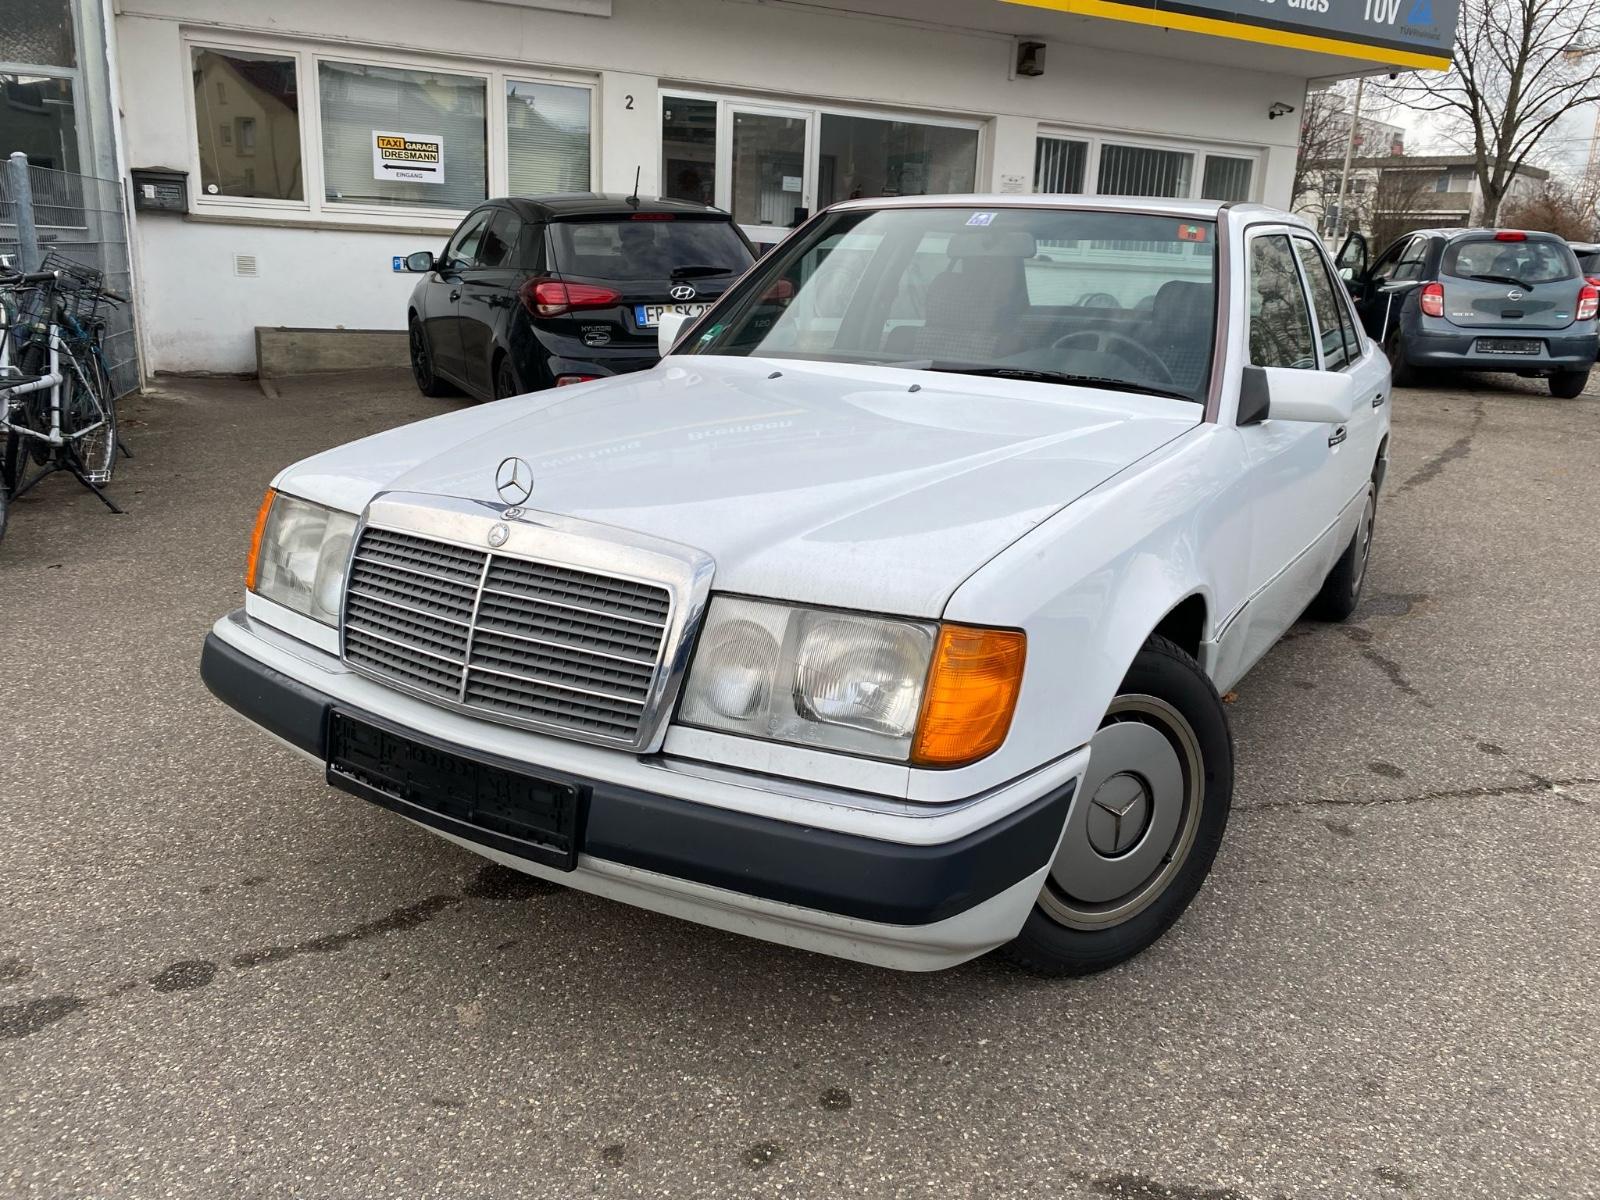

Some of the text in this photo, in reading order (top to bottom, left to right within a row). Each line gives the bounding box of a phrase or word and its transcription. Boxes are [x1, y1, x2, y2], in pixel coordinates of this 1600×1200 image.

[624, 94, 634, 110] 2
[379, 138, 438, 152] TAXI GARAGE
[384, 150, 437, 161] DRESMANN
